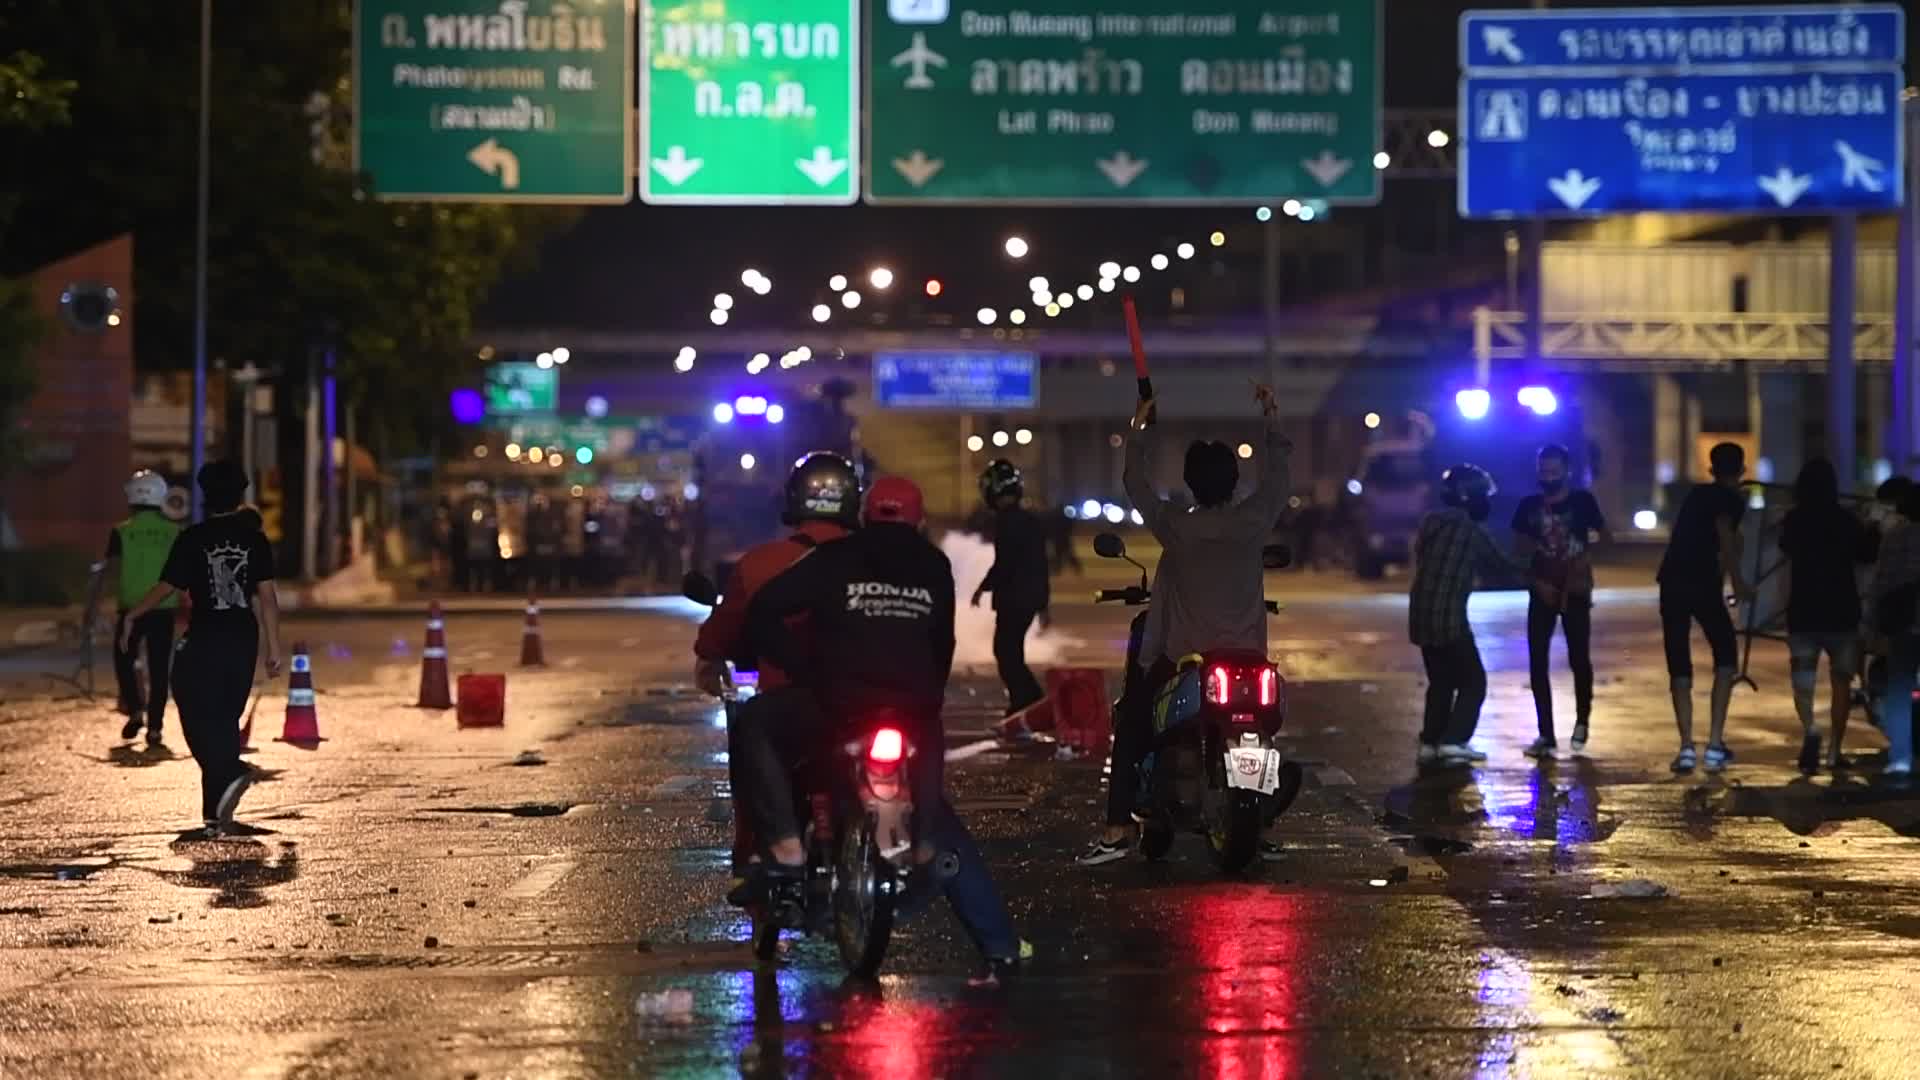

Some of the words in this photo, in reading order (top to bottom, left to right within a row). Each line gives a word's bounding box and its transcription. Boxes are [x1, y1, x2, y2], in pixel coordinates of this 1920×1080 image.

[424, 1, 605, 50] พหลโยธิน
[663, 22, 840, 60] ทหารบก
[971, 47, 1142, 96] ลาดพร้าว
[1180, 44, 1353, 95] ดอนเมือง
